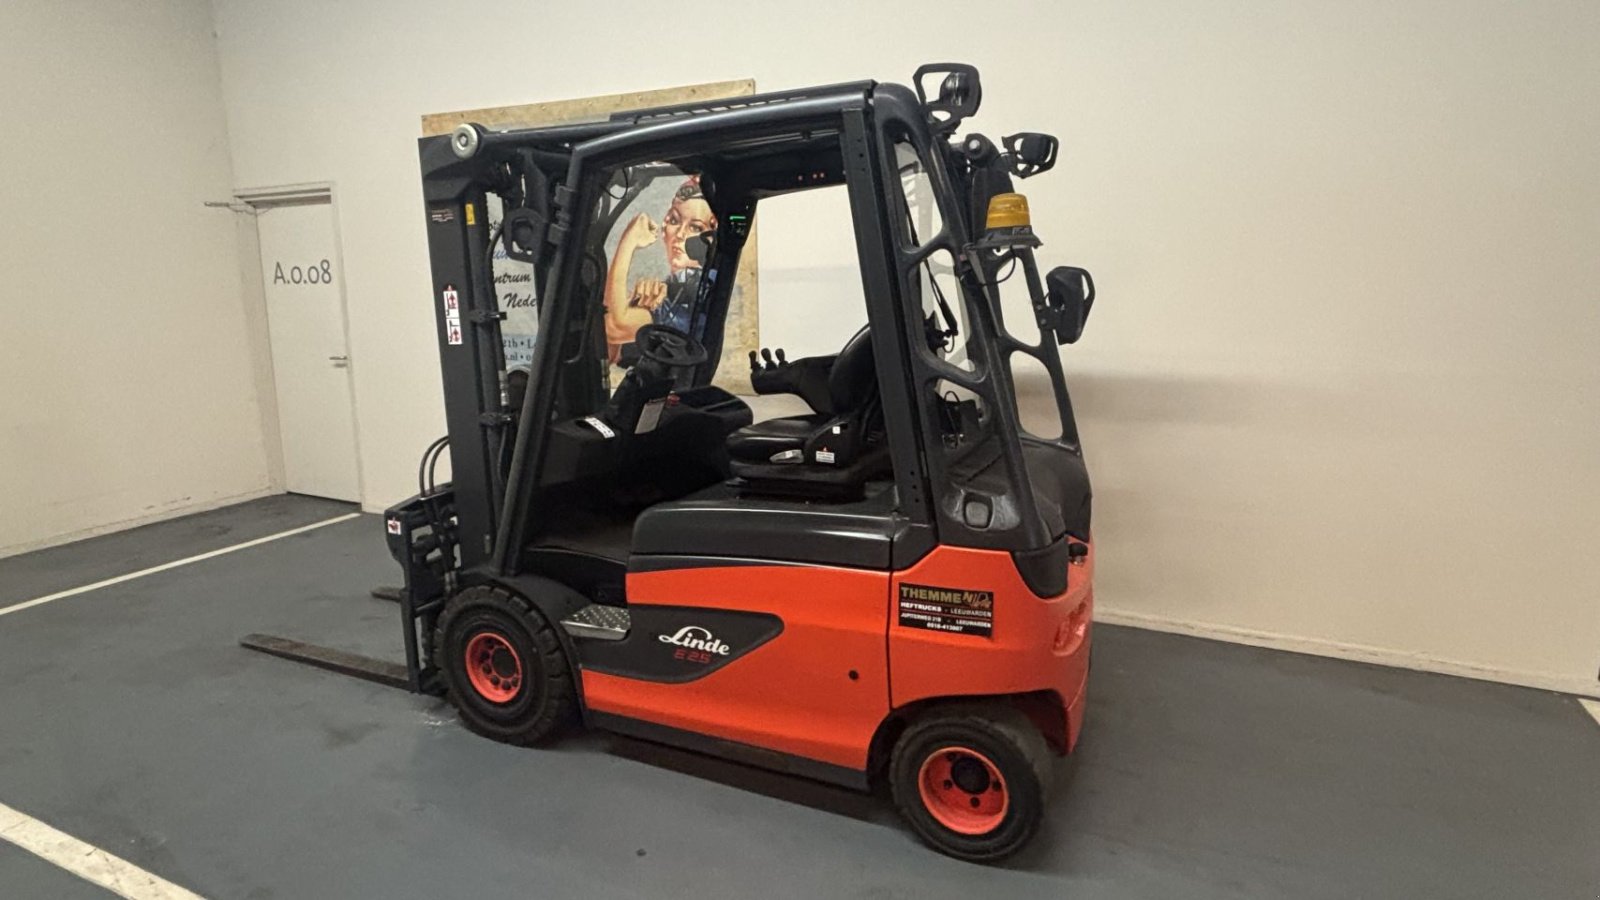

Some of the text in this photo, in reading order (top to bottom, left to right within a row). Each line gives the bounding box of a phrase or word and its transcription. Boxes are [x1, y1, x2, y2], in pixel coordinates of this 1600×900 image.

[494, 272, 531, 284] ntrum
[900, 602, 992, 617] HEFTRUCKS LEEUWARDEN
[956, 619, 992, 628] LEEUWARDEN
[658, 625, 730, 656] Linde
